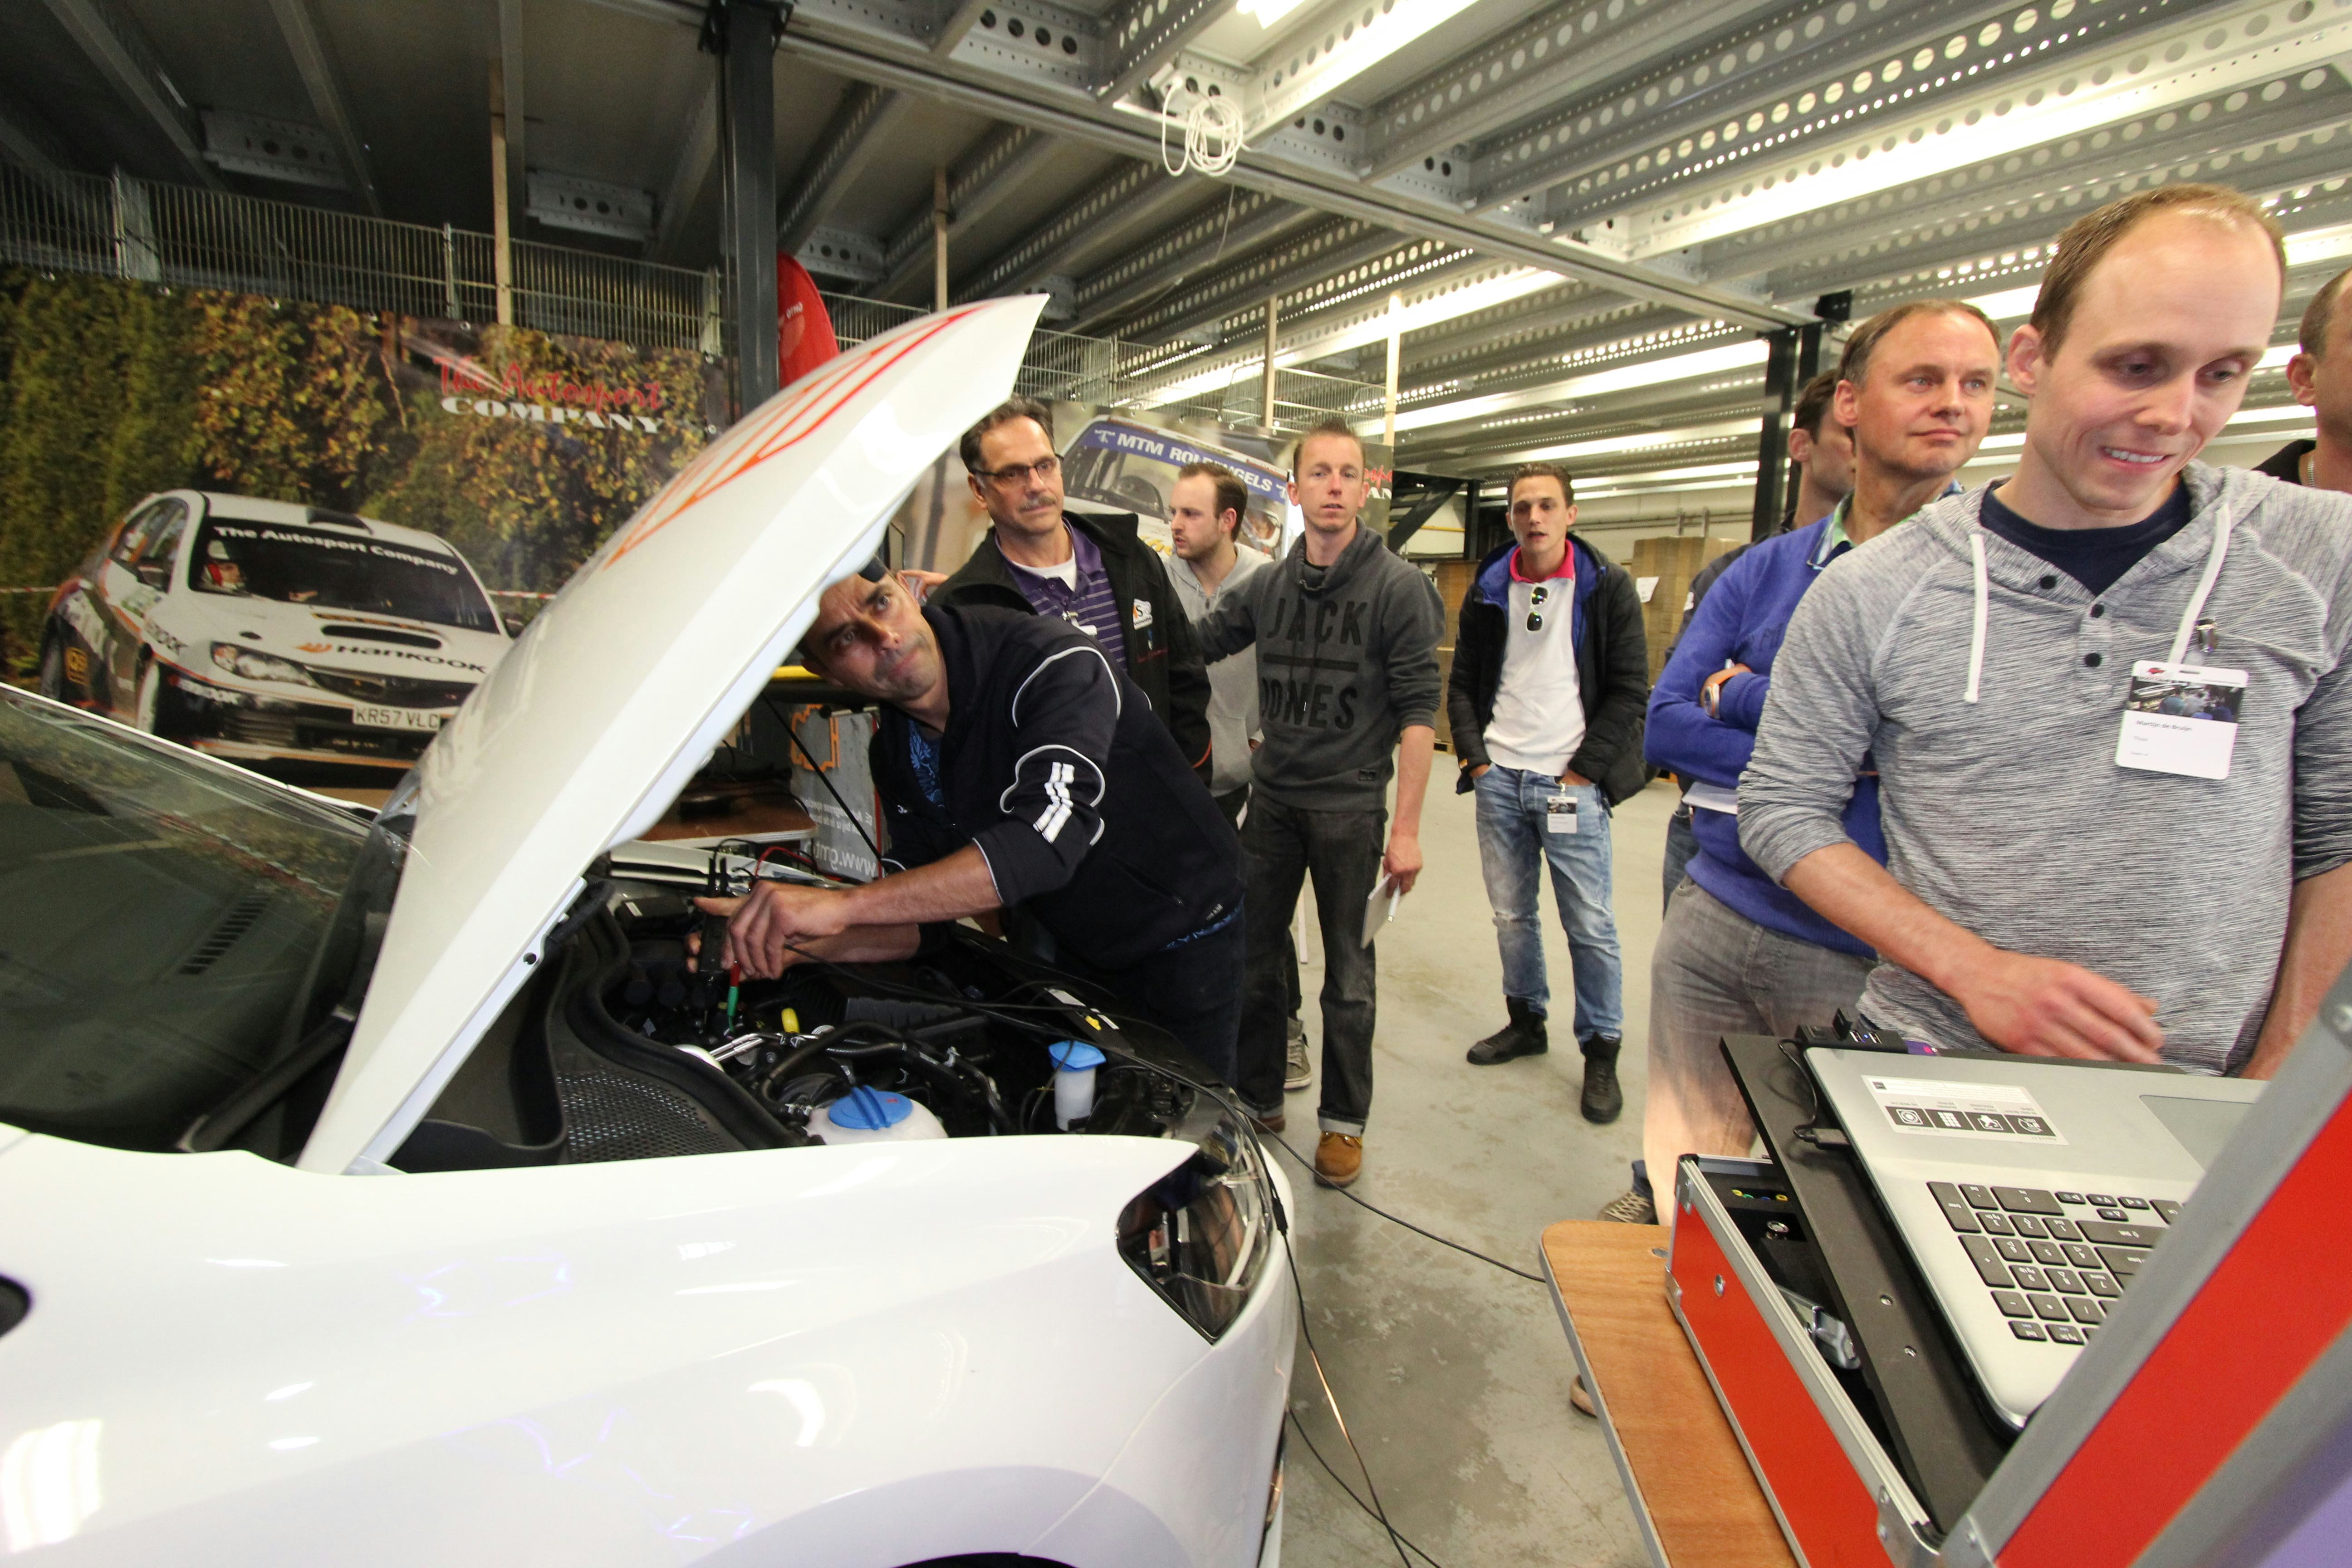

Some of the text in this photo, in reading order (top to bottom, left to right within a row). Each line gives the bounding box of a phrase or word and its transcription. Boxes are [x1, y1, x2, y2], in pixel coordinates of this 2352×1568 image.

[433, 356, 664, 413] The Autosport
[441, 396, 665, 434] COMPANY
[1117, 433, 1164, 456] MTM
[213, 526, 458, 575] The Autosport Company
[1266, 598, 1367, 645] JACK
[355, 708, 402, 725] KR57
